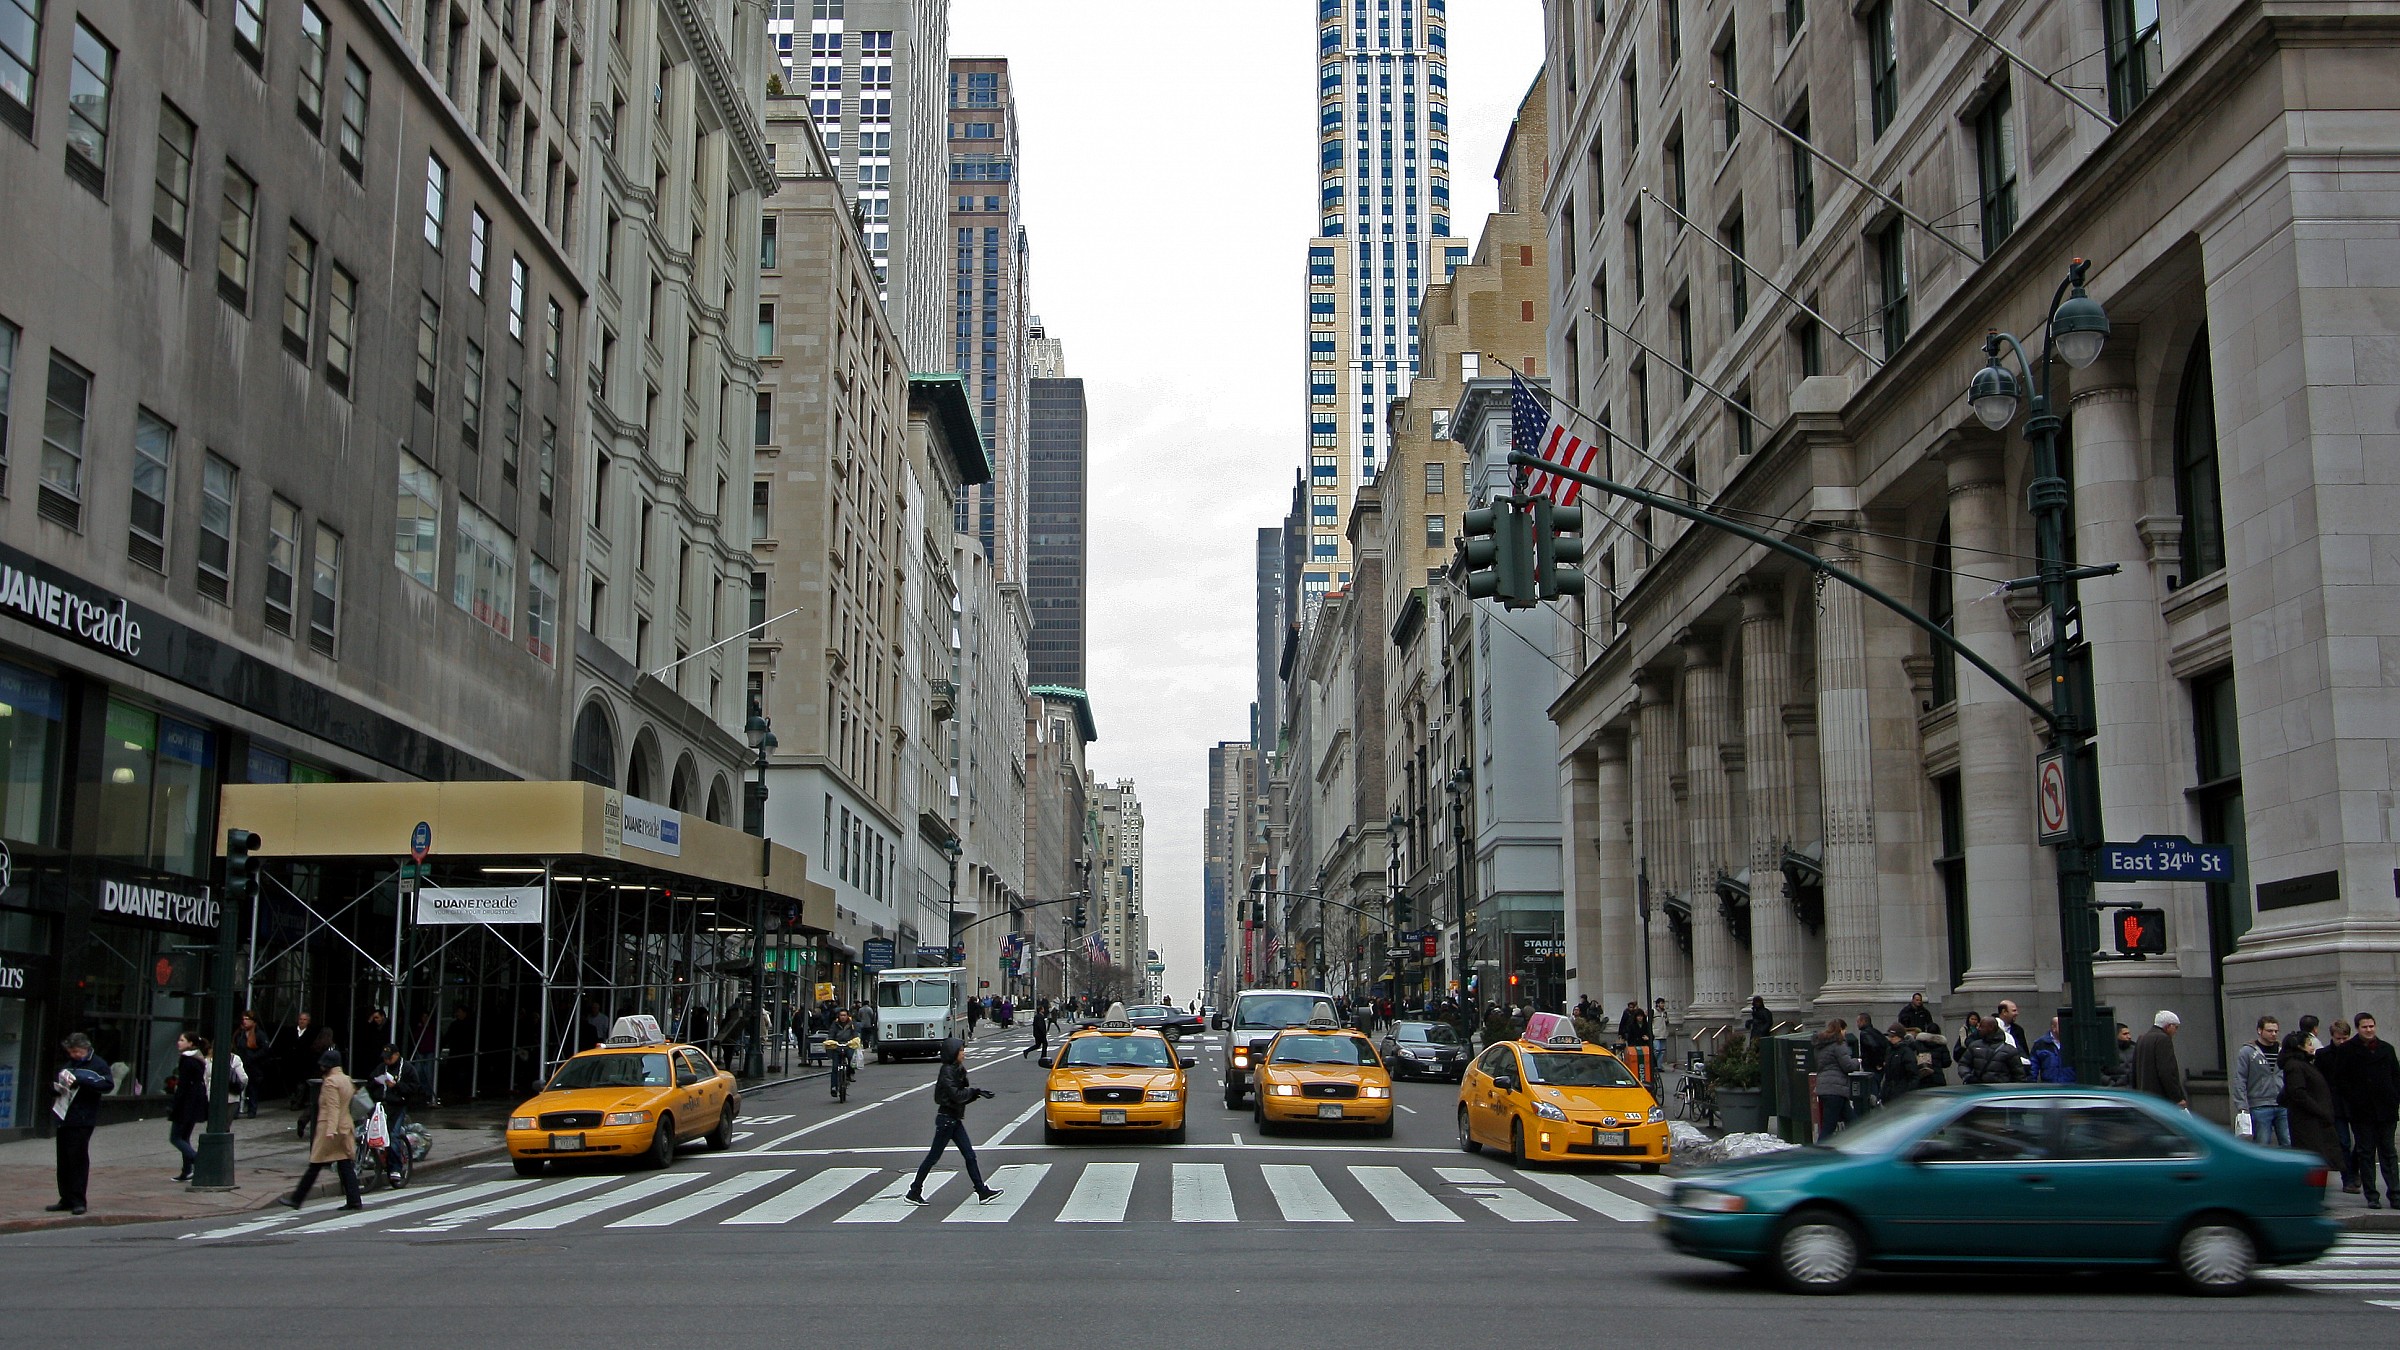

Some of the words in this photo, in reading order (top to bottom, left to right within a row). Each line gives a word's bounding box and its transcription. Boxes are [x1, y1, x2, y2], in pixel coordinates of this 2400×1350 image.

[2111, 852, 2153, 871] East
[2158, 851, 2194, 871] 34th
[2200, 853, 2221, 872] St
[104, 880, 220, 929] DUANEreade
[434, 895, 518, 909] DUANEreade
